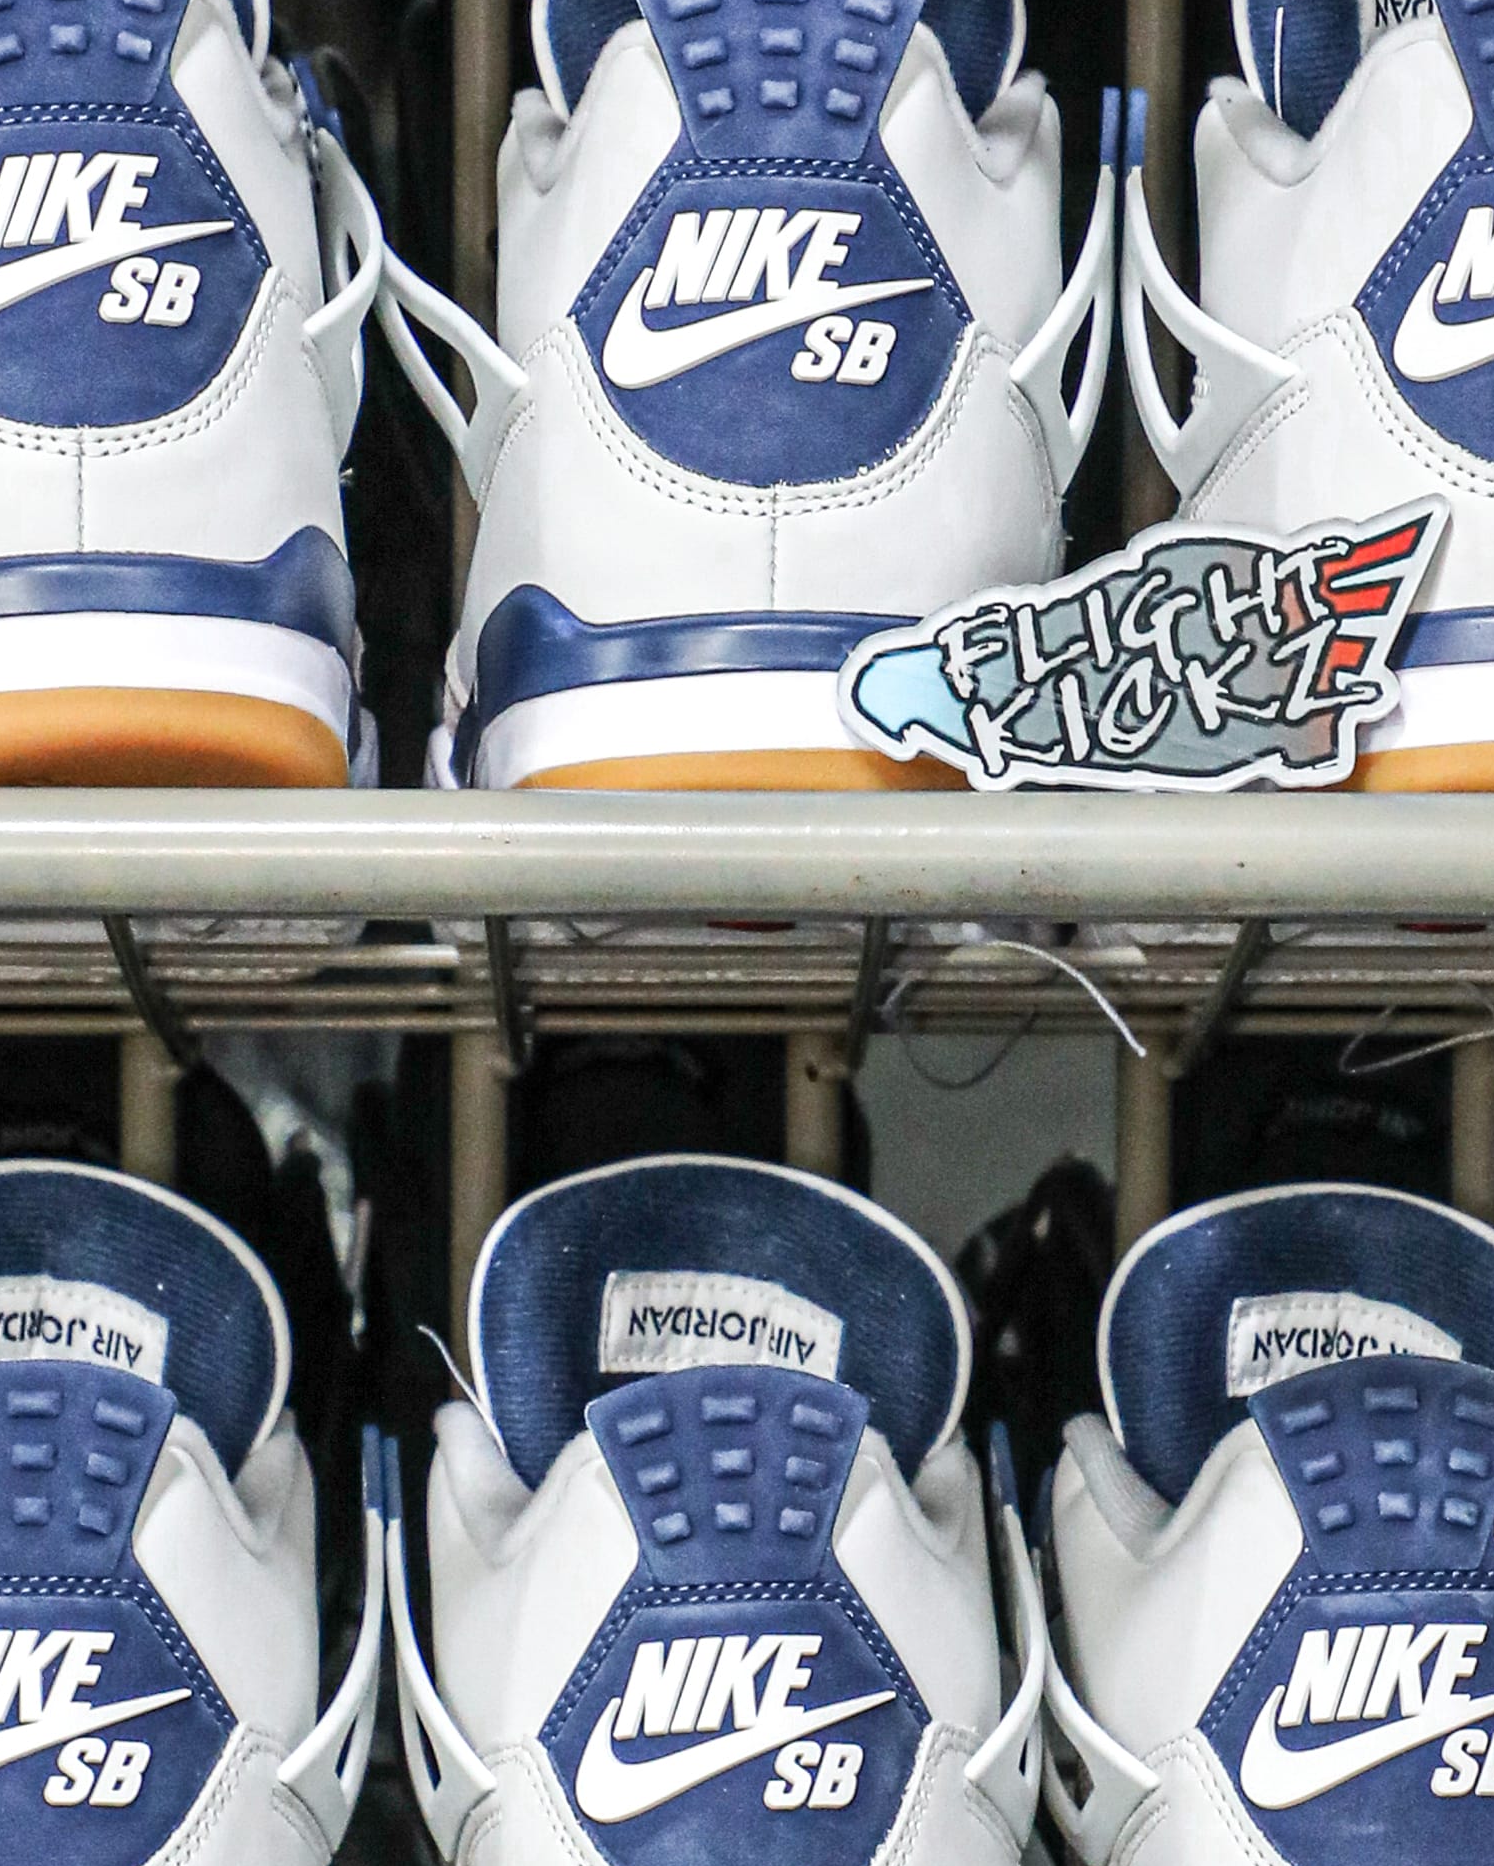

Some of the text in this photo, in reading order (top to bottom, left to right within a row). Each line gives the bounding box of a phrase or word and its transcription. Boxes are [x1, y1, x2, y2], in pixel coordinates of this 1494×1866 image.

[96, 254, 203, 329] SB
[644, 207, 862, 308] NIKE
[788, 313, 899, 387] SB
[934, 537, 1350, 698] FLIGHT
[965, 620, 1381, 776] KICKZ
[92, 1325, 143, 1368] AIR
[629, 1305, 767, 1345] JORDAN
[611, 1633, 820, 1738] NIKE
[1276, 1622, 1486, 1727] NIKE
[41, 1735, 153, 1807] SB
[761, 1738, 866, 1811] SB
